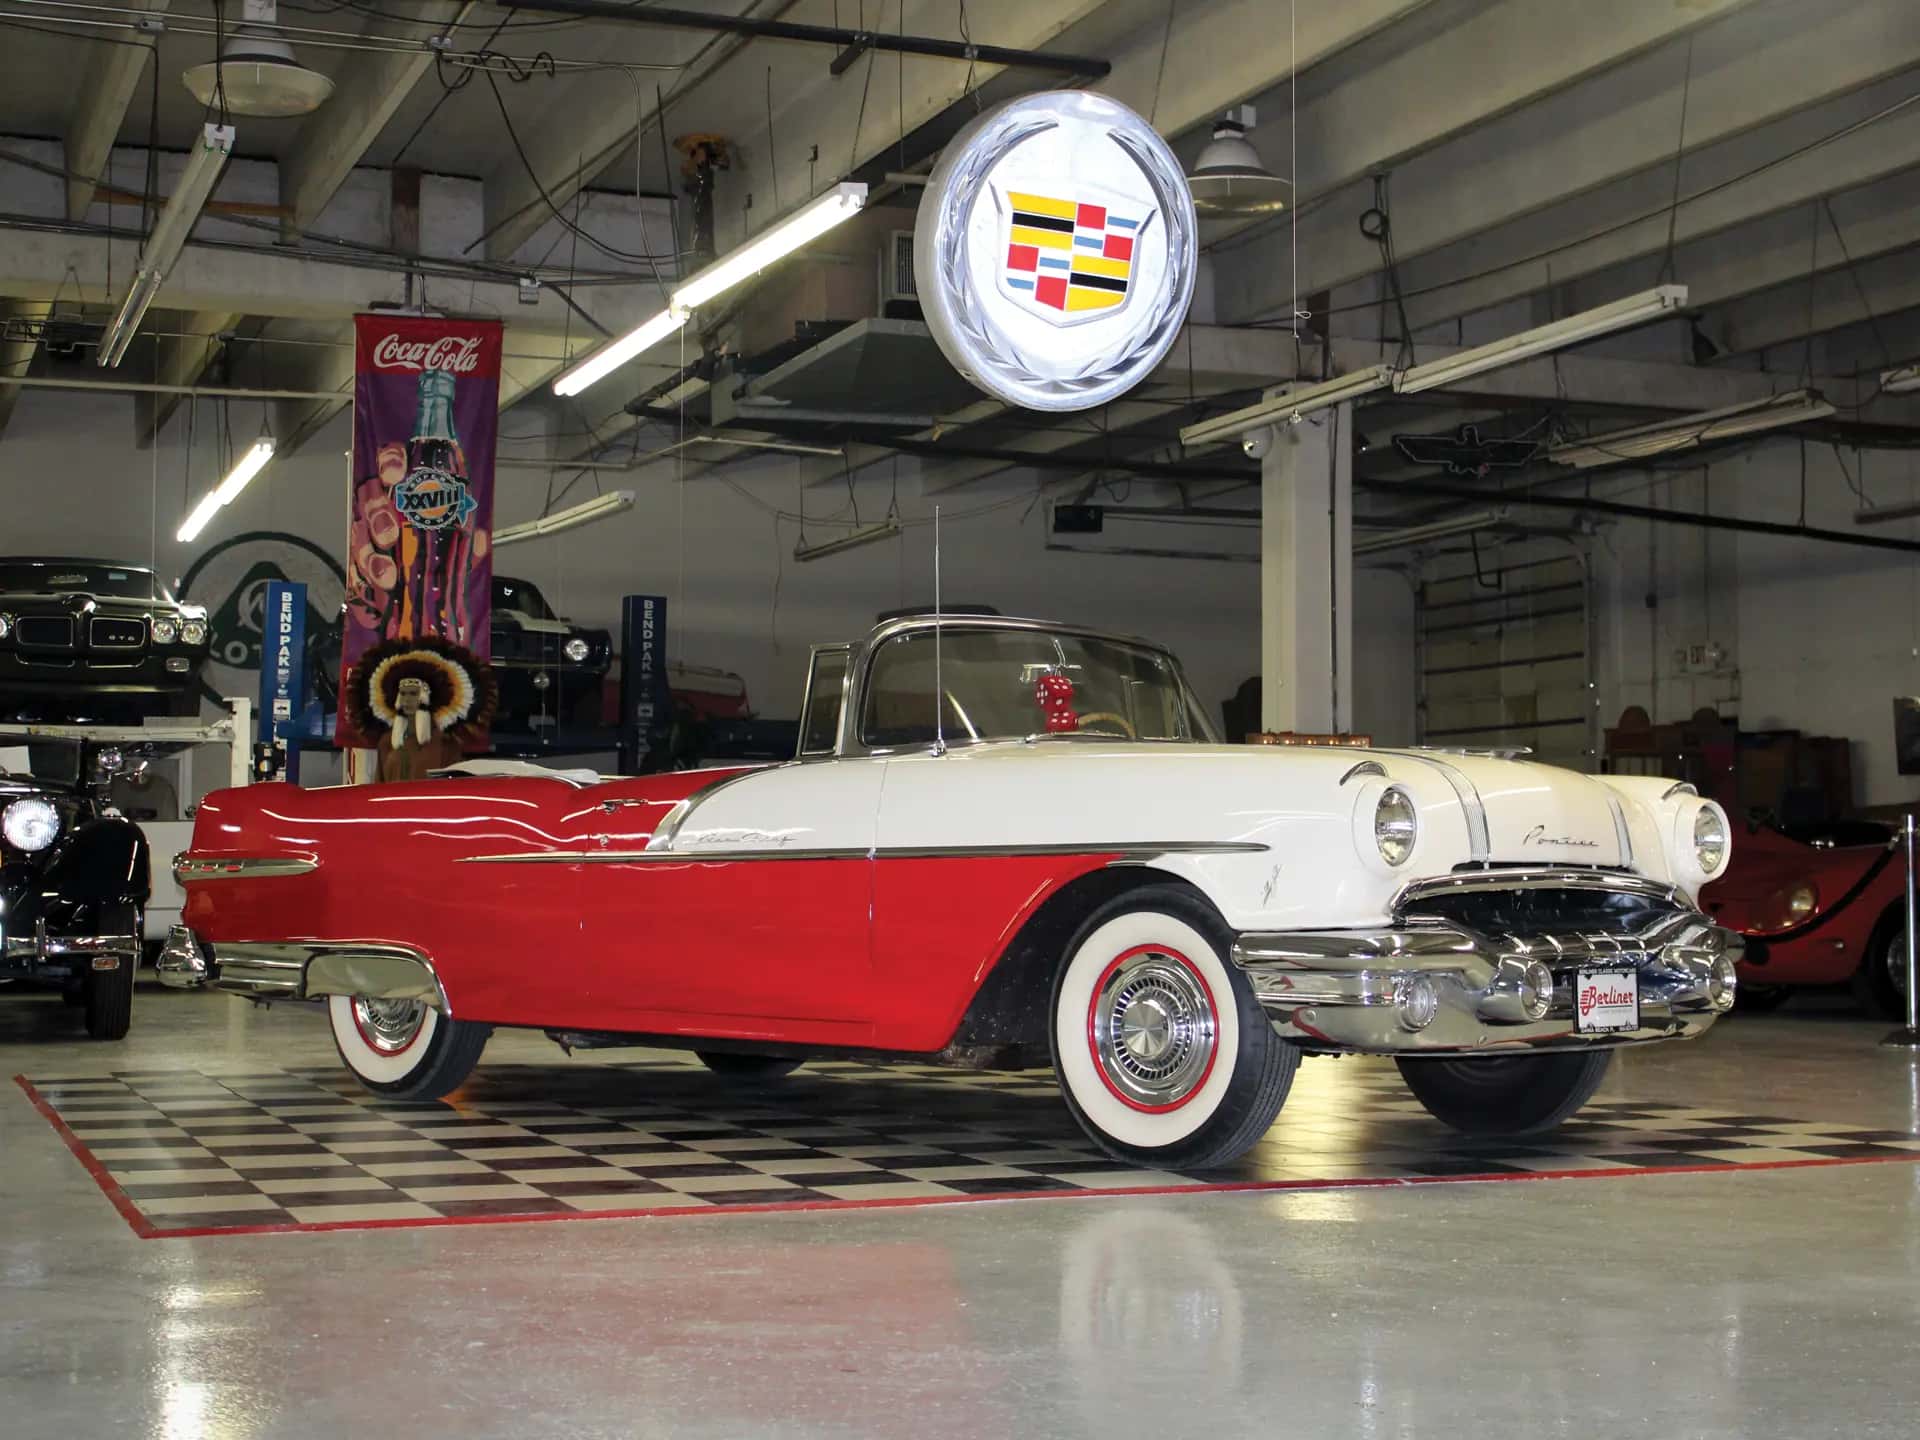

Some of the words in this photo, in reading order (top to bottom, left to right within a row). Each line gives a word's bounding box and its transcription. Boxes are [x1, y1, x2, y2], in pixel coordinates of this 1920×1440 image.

[373, 333, 483, 372] Coca-Cola
[278, 592, 293, 667] BENDPAK
[642, 600, 654, 671] BENDPAK
[1580, 985, 1633, 1016] Berliner
